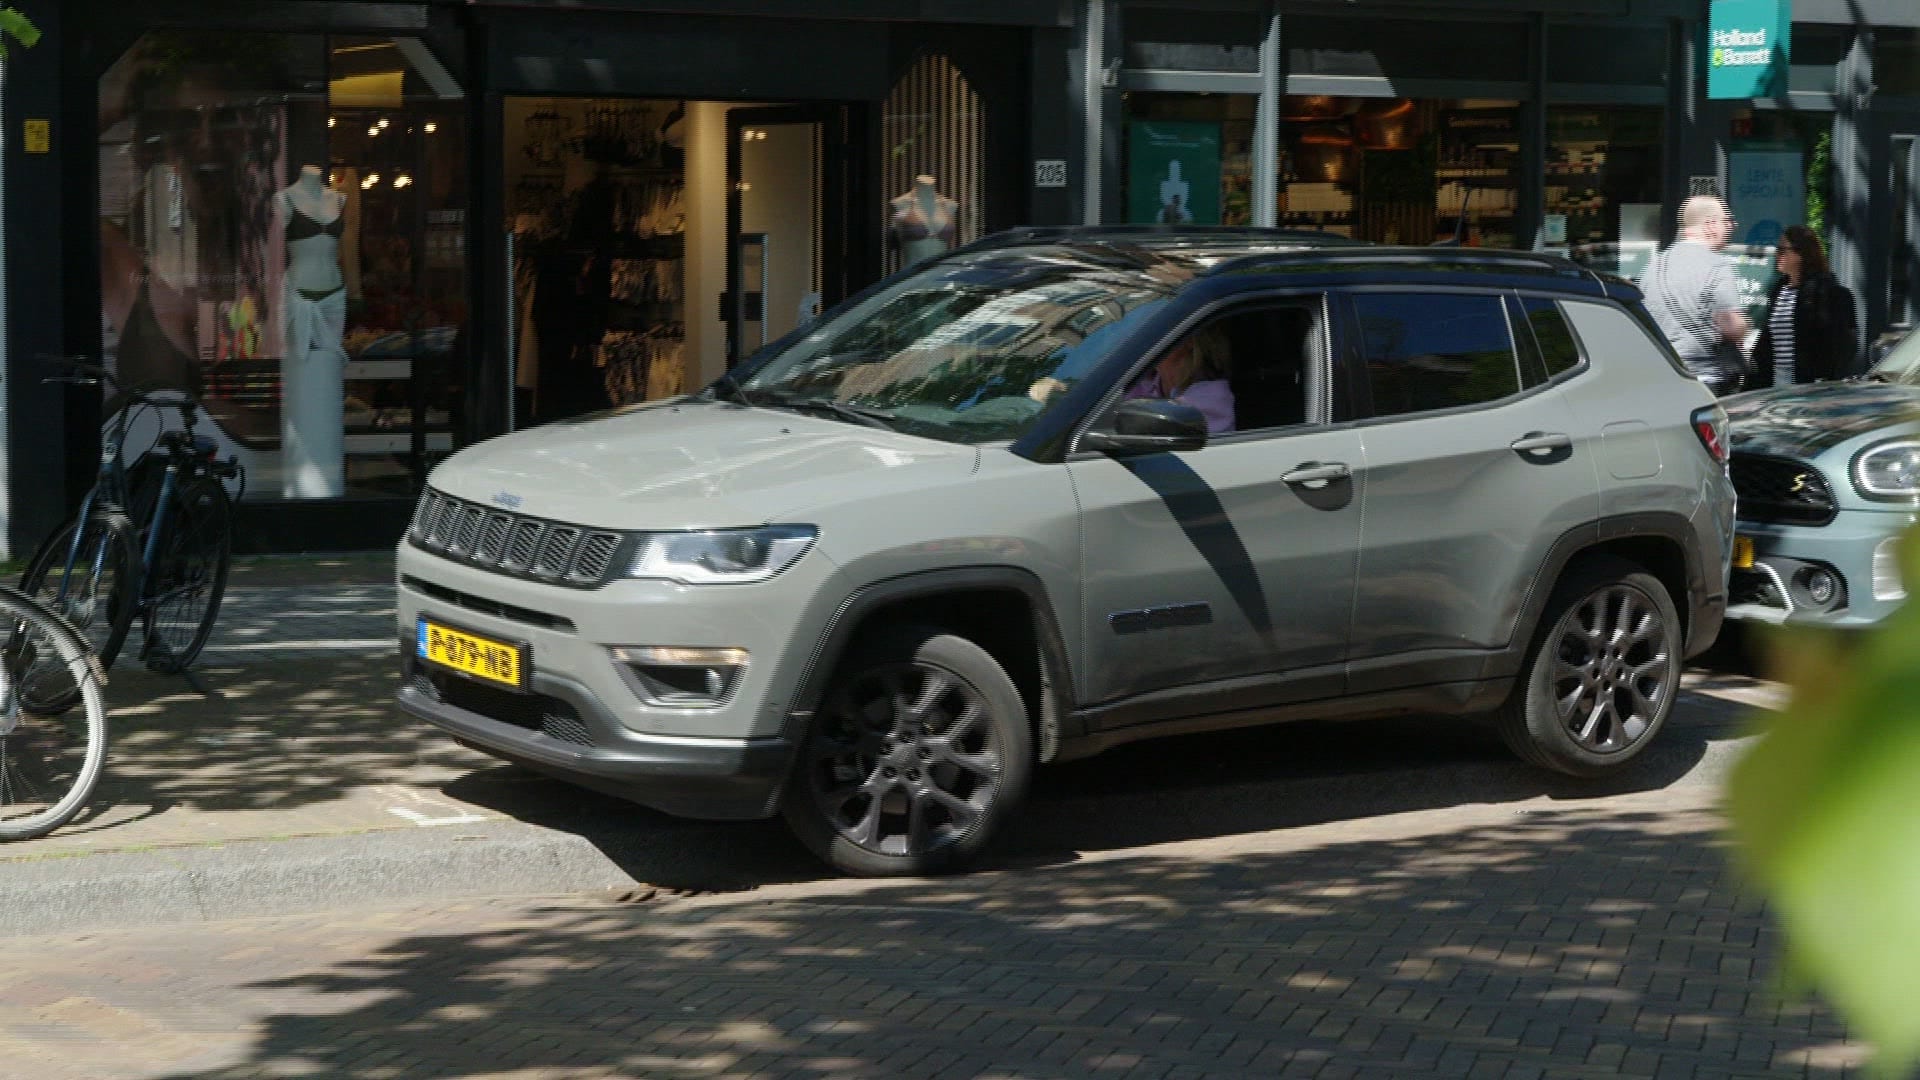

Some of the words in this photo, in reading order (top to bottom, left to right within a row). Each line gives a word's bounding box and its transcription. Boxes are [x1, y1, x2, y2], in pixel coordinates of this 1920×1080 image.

[1712, 28, 1766, 47] Holland
[1037, 164, 1064, 184] 205
[430, 629, 513, 679] P-879-NB
